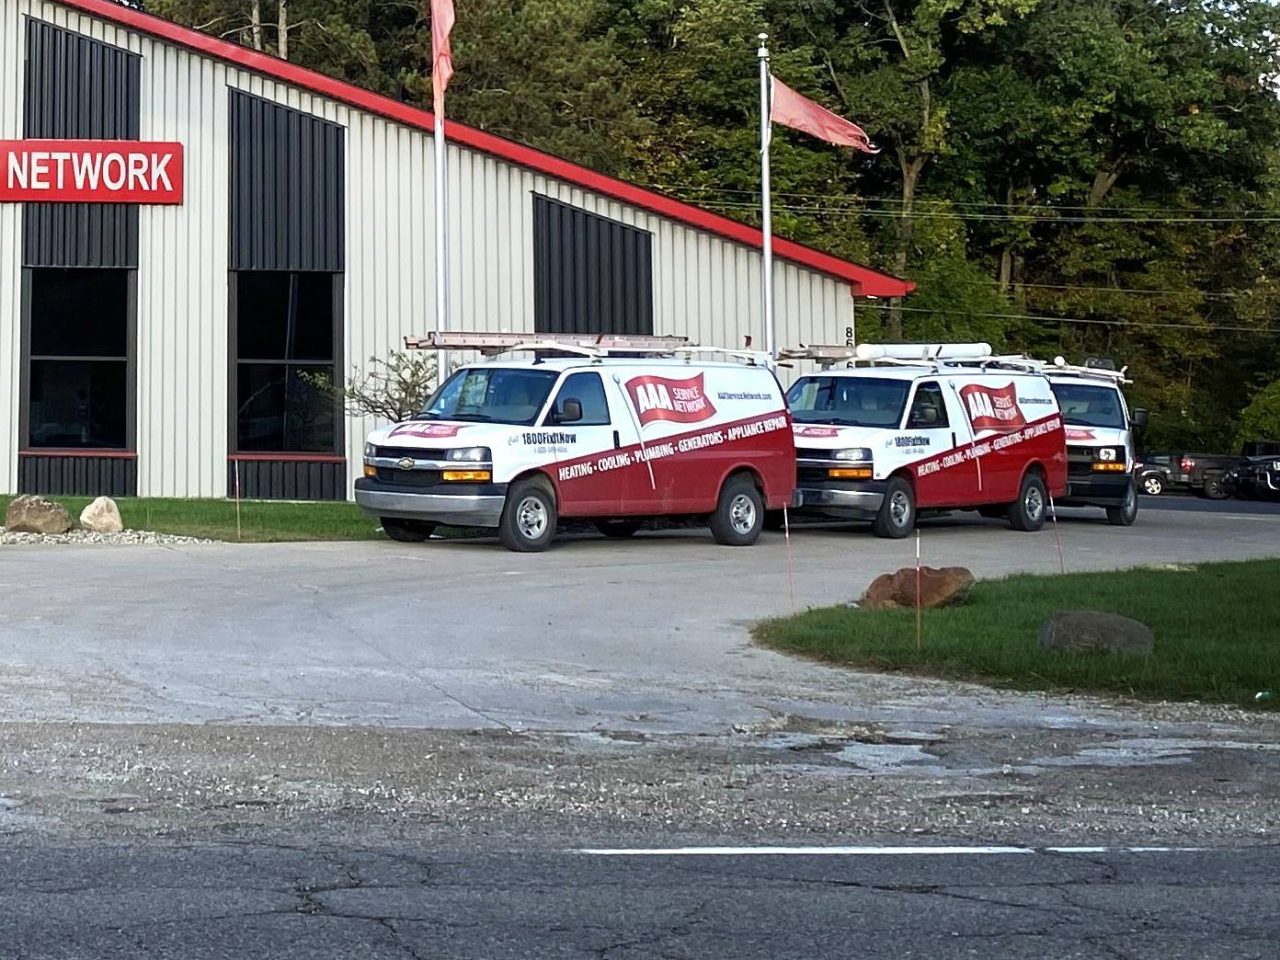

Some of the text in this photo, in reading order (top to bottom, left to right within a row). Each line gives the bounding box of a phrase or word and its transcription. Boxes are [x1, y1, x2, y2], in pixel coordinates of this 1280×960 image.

[7, 151, 173, 192] NETWORK
[636, 383, 673, 414] AAA
[672, 385, 699, 400] SERVICE
[673, 397, 706, 413] NETWORK
[967, 392, 995, 420] AAA
[522, 432, 577, 445] 1800FixItNow
[559, 416, 787, 481] HEATING COOLING PLUMBING GENERATORS APPLIANCE REPAIR
